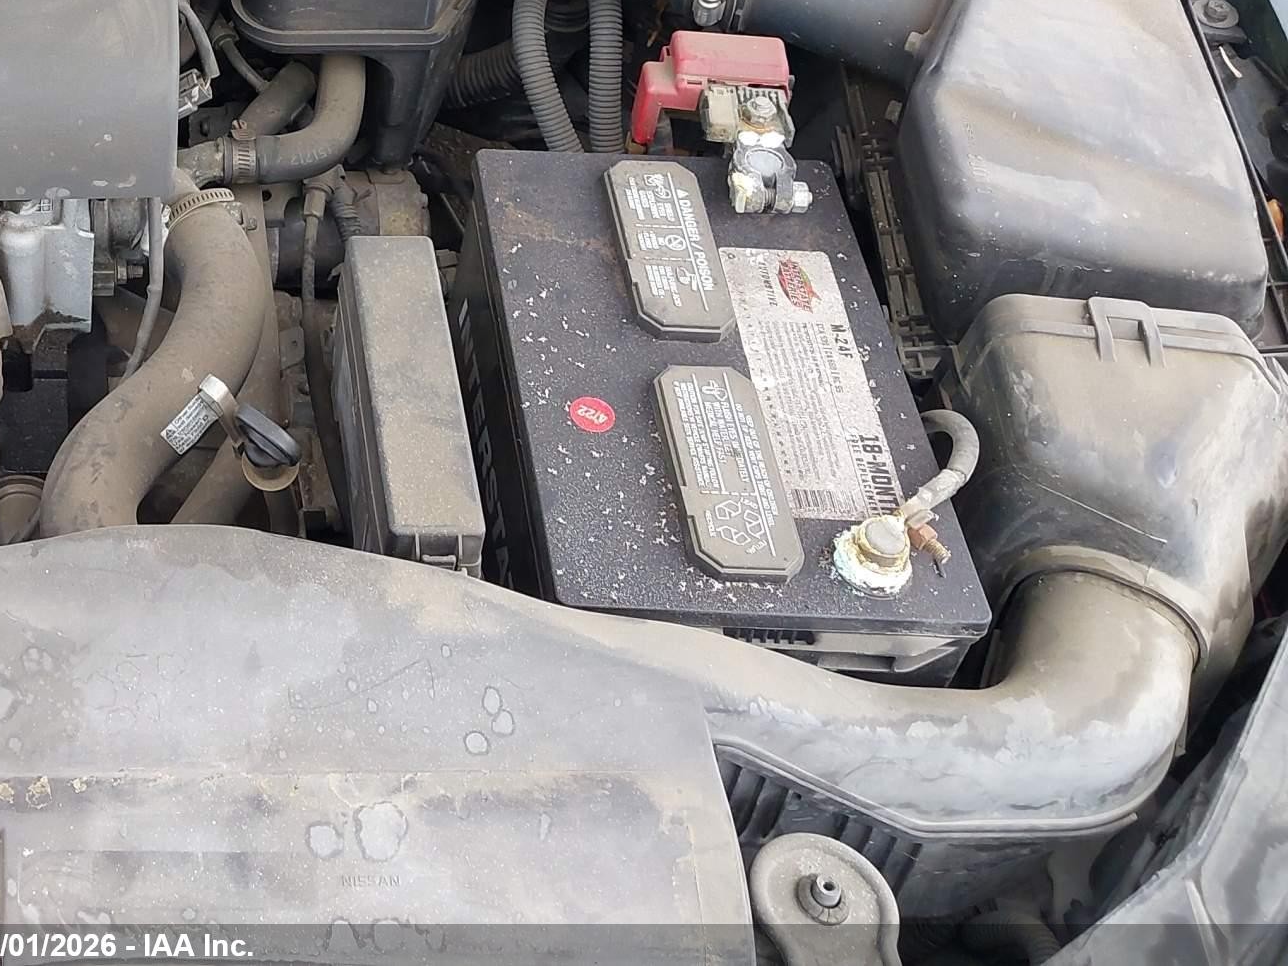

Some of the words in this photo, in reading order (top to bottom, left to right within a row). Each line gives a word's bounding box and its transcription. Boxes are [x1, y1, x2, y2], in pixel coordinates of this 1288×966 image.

[678, 199, 700, 240] DANGER
[693, 251, 714, 290] POISON
[789, 261, 812, 311] INTERSTATE
[829, 324, 853, 358] M-24F
[458, 296, 515, 590] INTERSTA
[710, 429, 722, 445] HELP
[726, 424, 738, 439] EYES
[848, 434, 862, 452] FREE
[855, 457, 881, 517] REPLACEMENT
[341, 873, 401, 888] NISSAN
